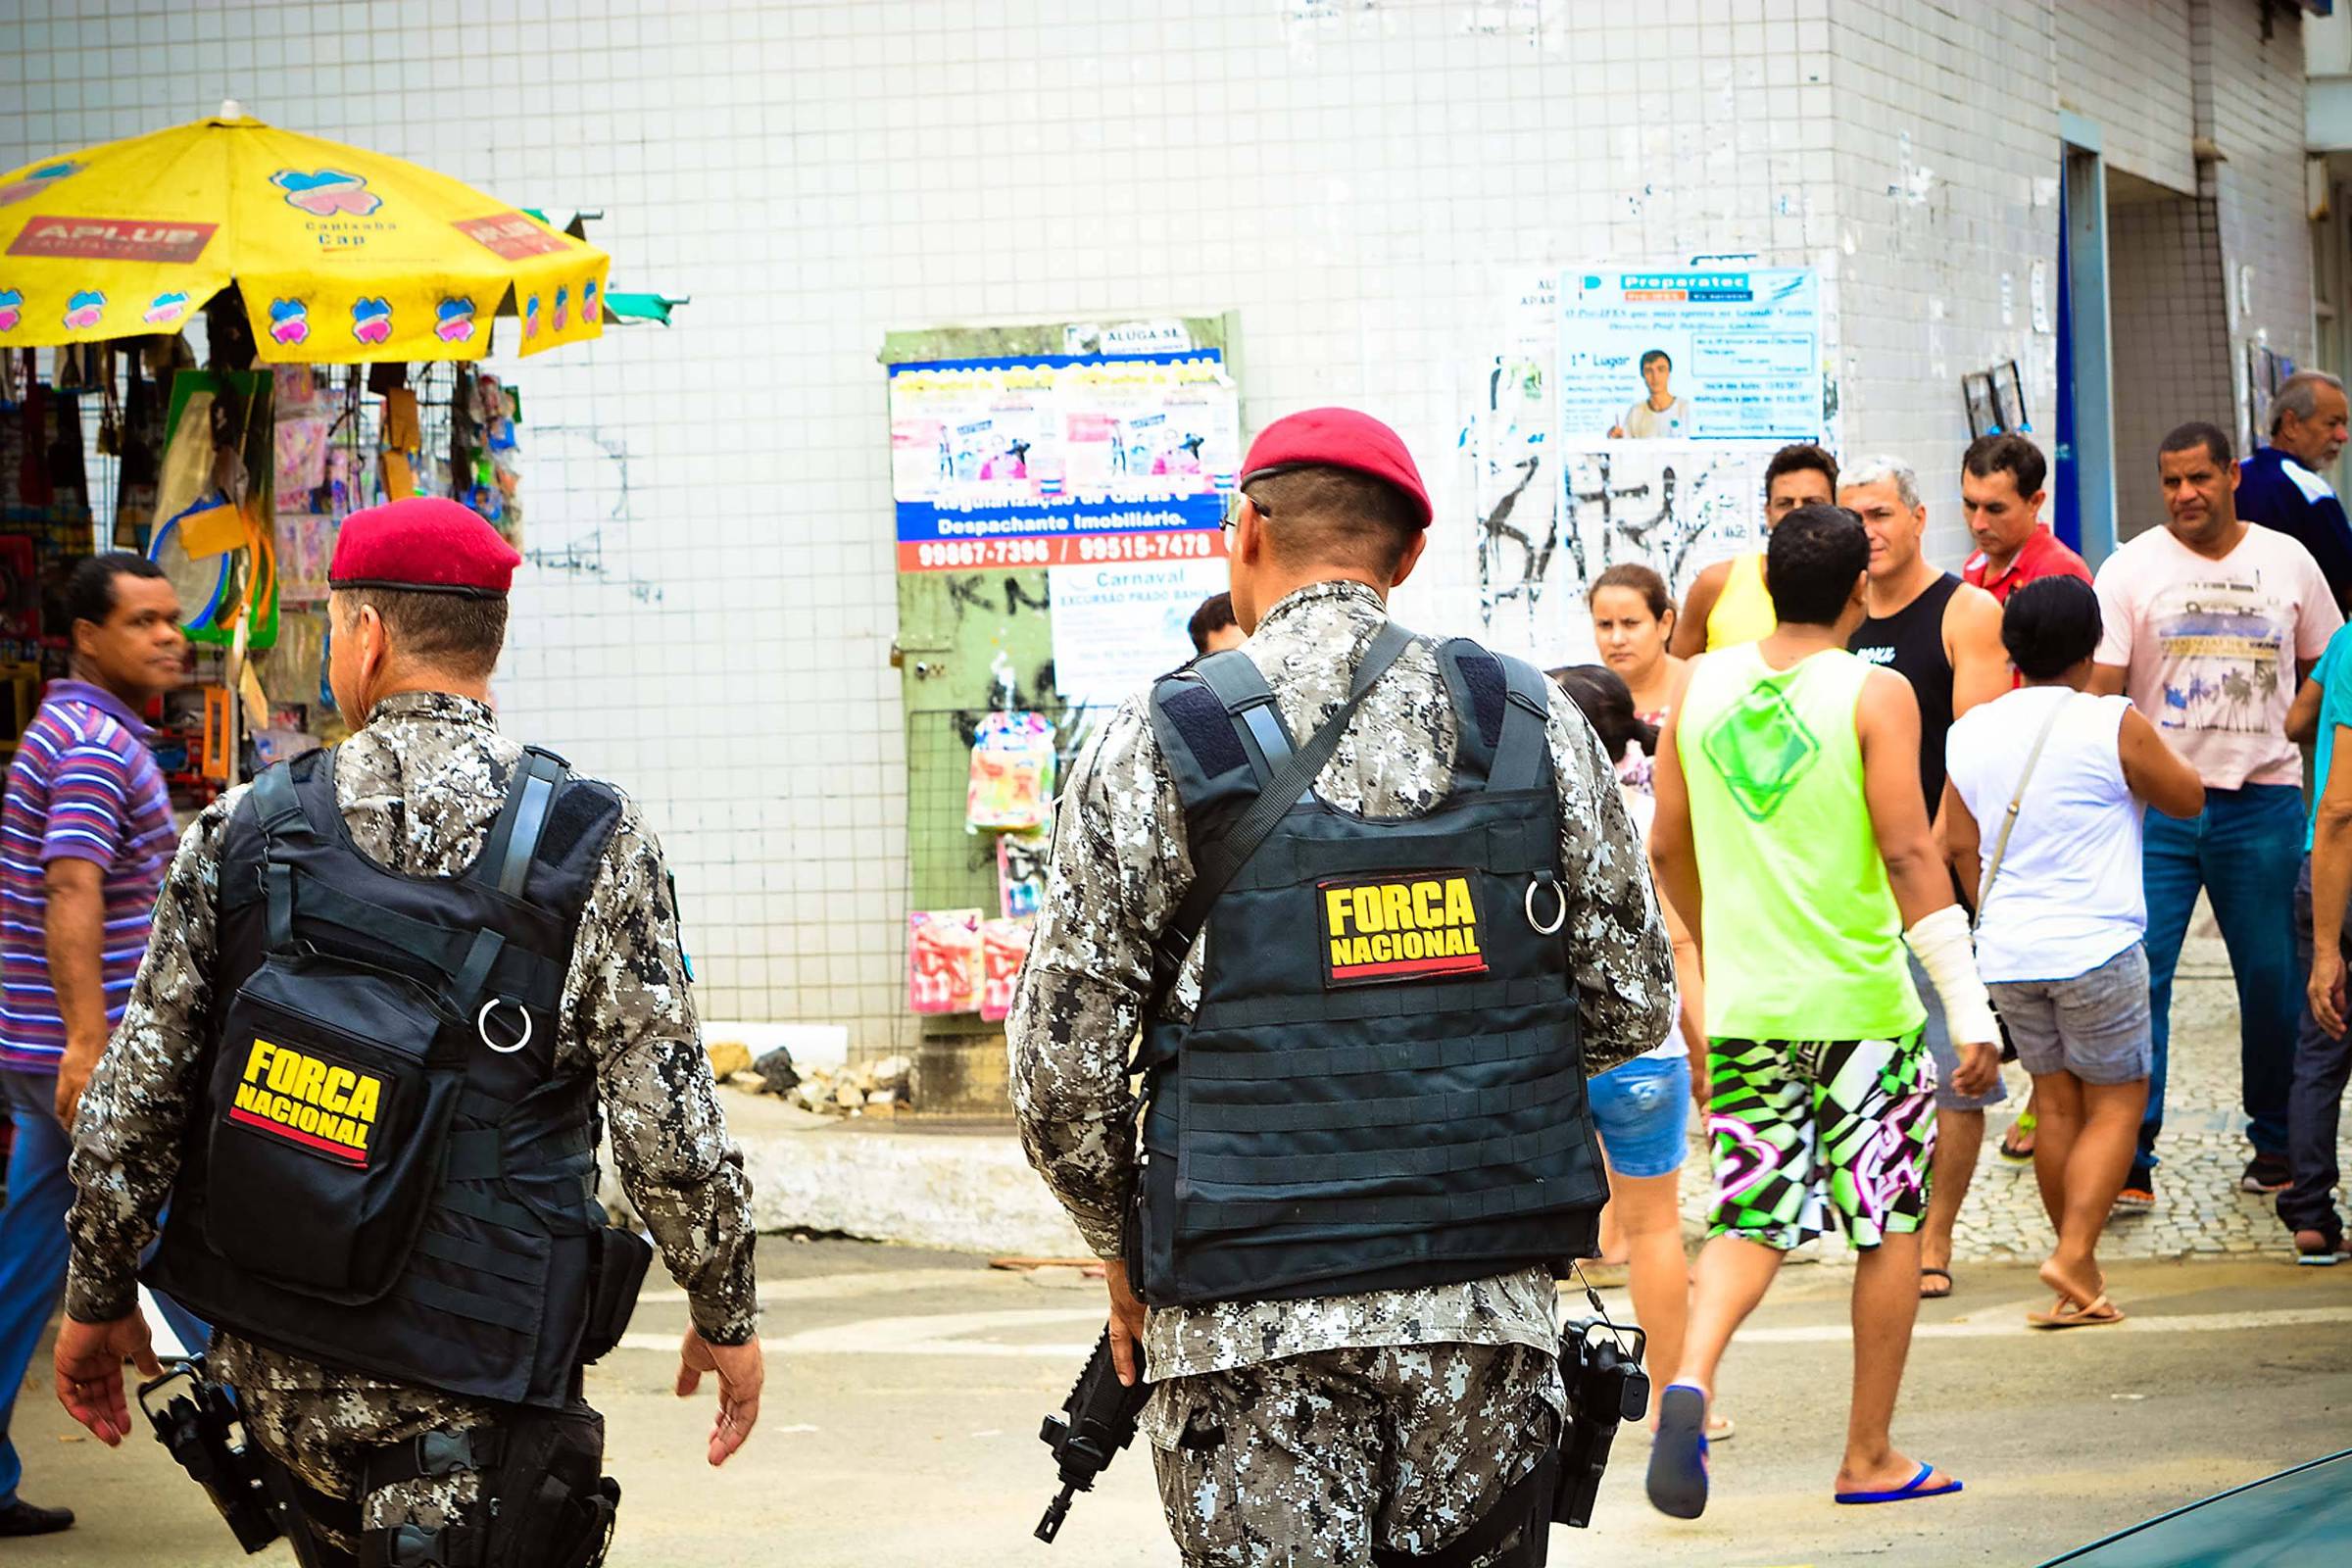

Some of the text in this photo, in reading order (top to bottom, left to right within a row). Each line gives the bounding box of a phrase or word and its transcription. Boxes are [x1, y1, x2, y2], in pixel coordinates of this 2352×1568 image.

[35, 223, 199, 244] APLUB
[318, 233, 366, 247] Cap
[1107, 328, 1157, 342] ALUGA
[1592, 354, 1631, 368] Lugar
[937, 510, 1188, 537] Despachante Imobiliário.
[1097, 567, 1185, 588] Carnaval
[1128, 590, 1169, 602] PRADO
[1329, 925, 1481, 966] NACIONAL
[233, 1081, 368, 1151] NACIONAL
